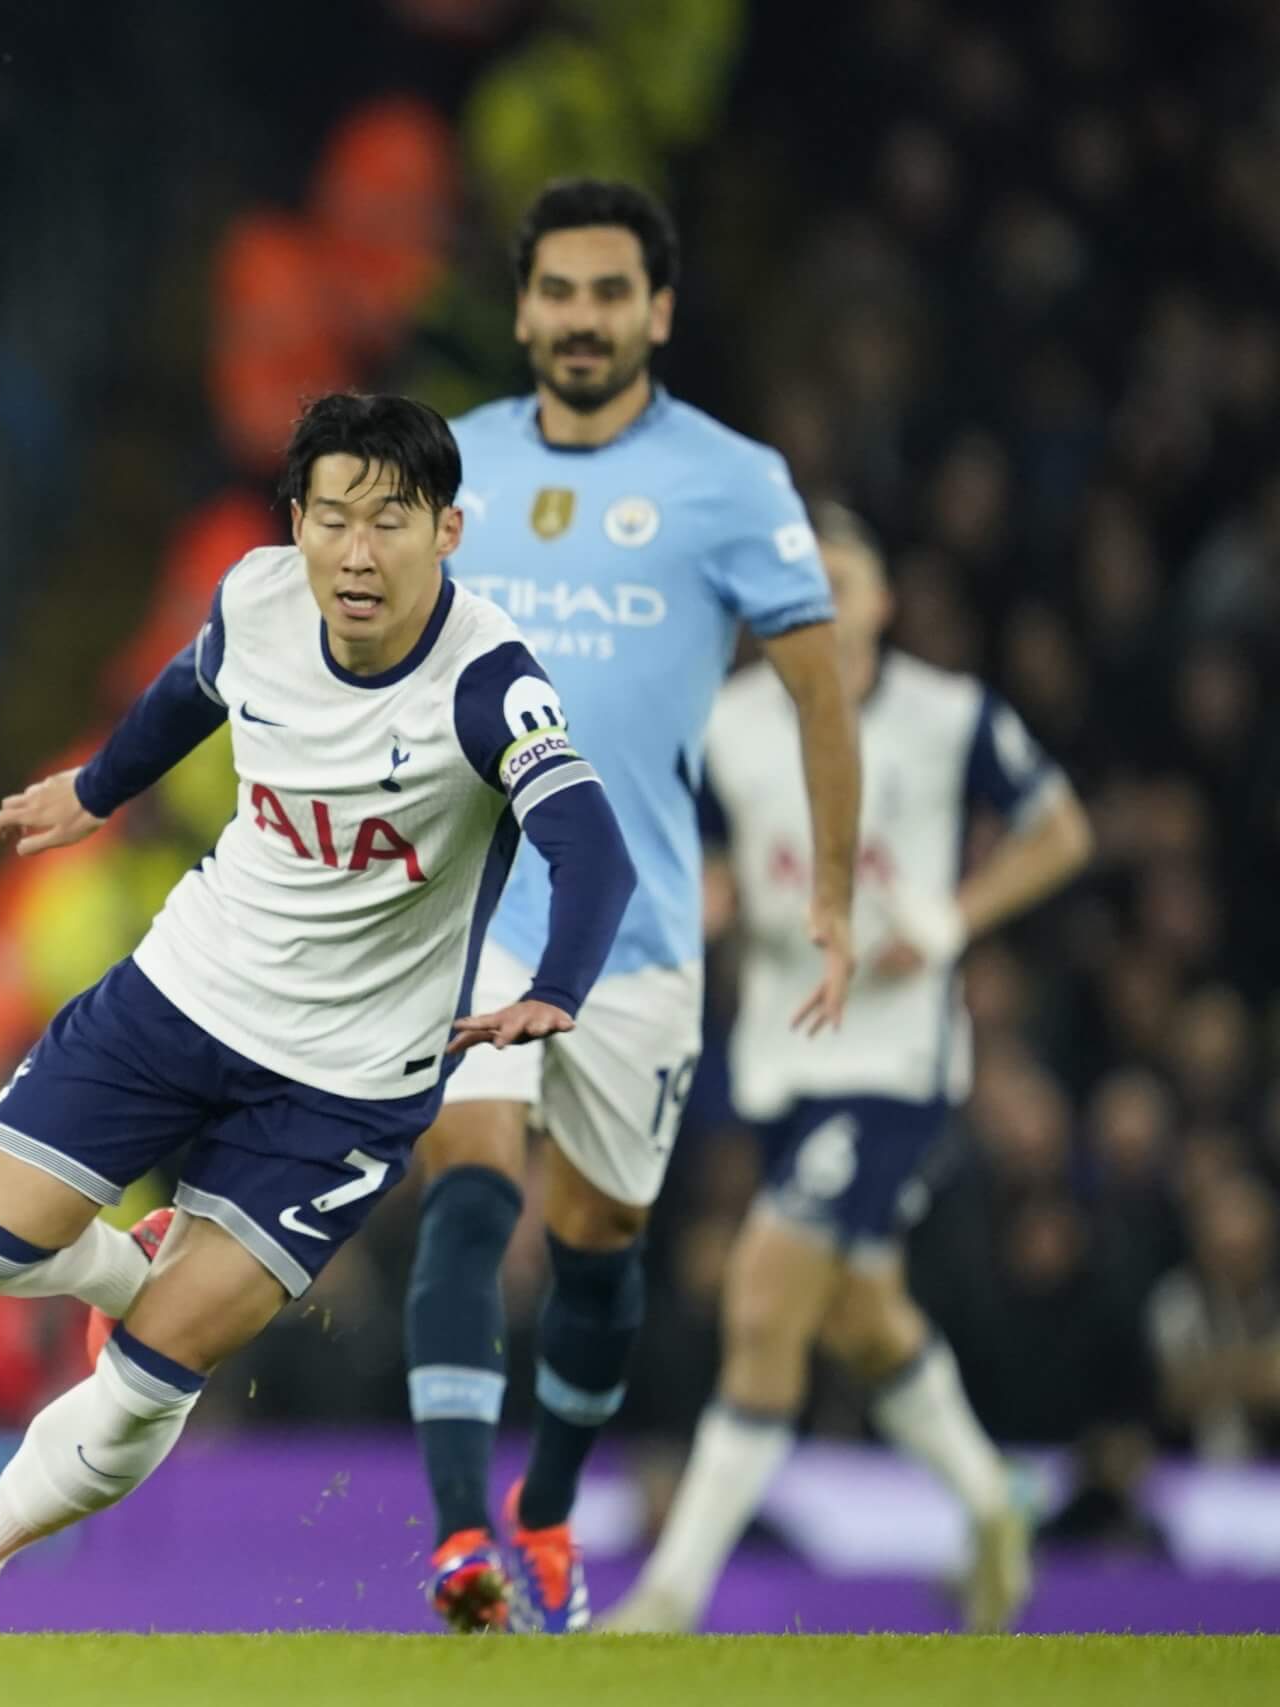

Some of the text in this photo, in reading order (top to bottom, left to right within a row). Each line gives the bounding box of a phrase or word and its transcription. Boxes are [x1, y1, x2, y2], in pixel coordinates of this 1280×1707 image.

[460, 574, 668, 627] TIHAD
[508, 737, 570, 775] capta
[250, 783, 428, 883] AIA
[310, 1148, 391, 1213] 7
